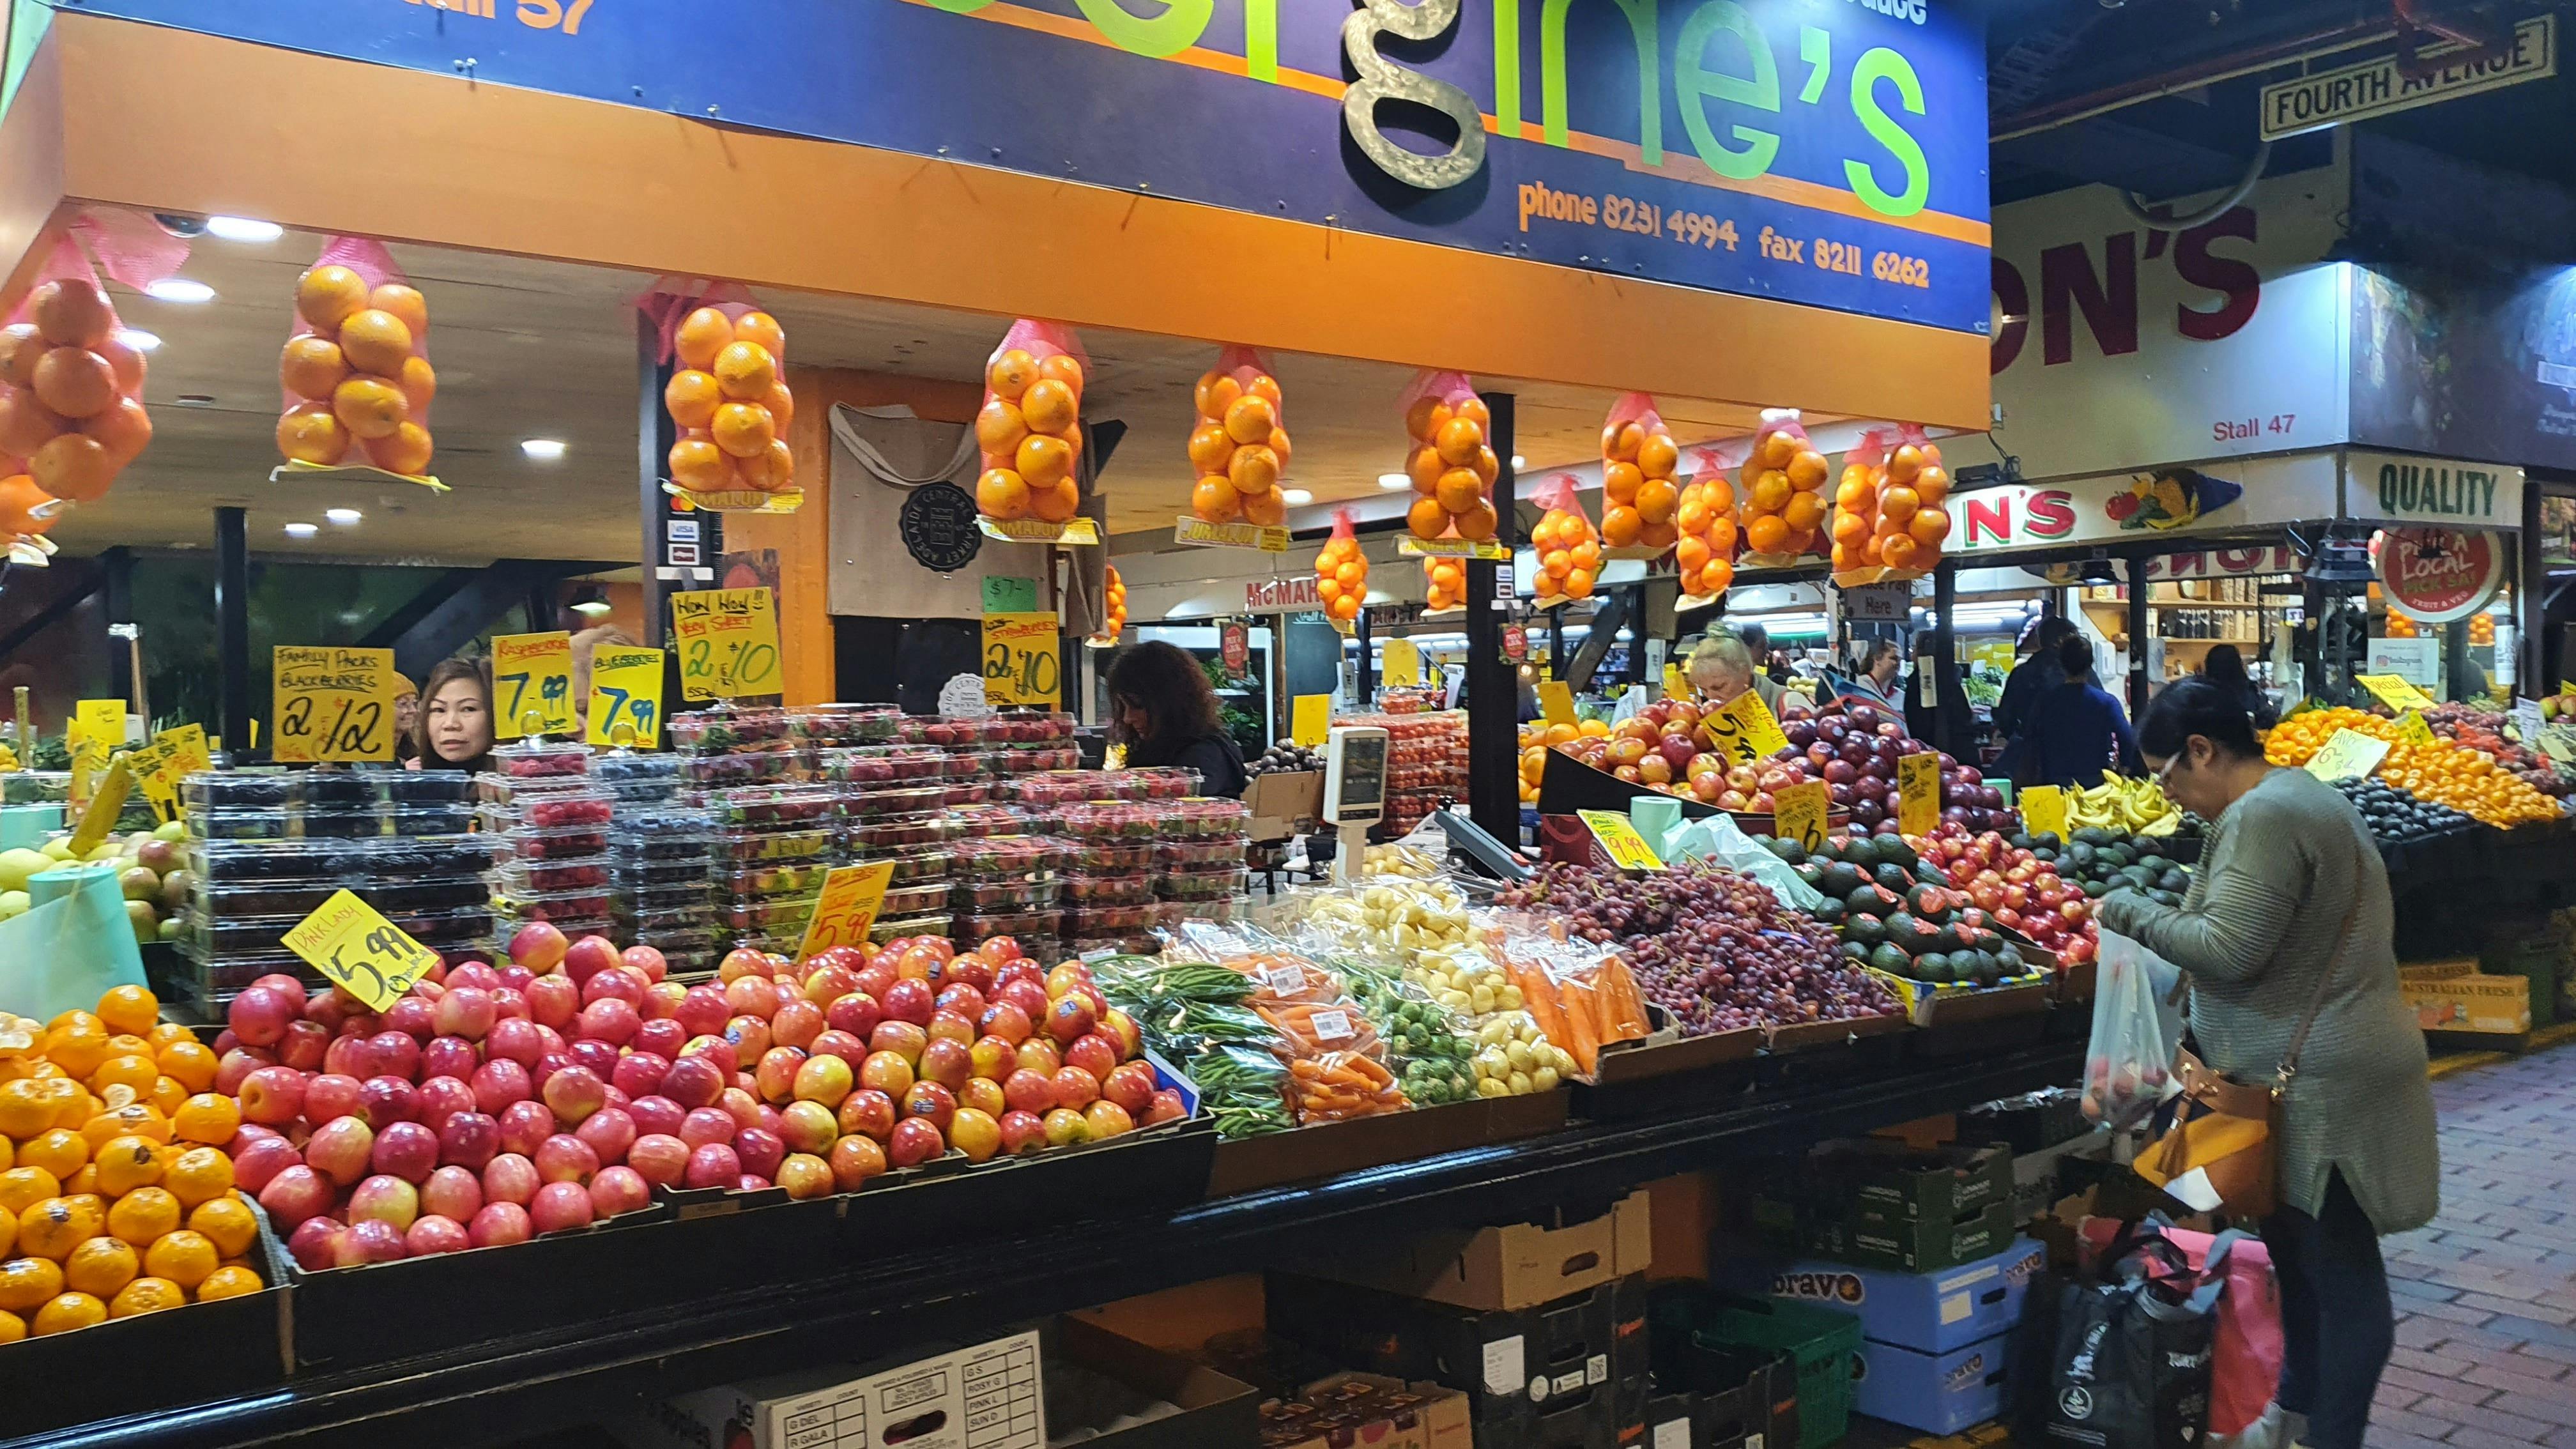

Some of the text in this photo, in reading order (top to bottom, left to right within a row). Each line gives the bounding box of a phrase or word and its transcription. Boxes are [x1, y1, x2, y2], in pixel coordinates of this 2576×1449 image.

[2277, 67, 2391, 124] FOURTH
[1519, 181, 1929, 288] phone 8231 4994 fax 8211 6262
[2213, 414, 2296, 441] Stall 47
[2379, 464, 2497, 515] QUALITY
[2402, 552, 2474, 580] LOCAL
[1865, 595, 1891, 614] Here
[319, 905, 364, 928] LADY
[800, 1414, 820, 1427] DEL
